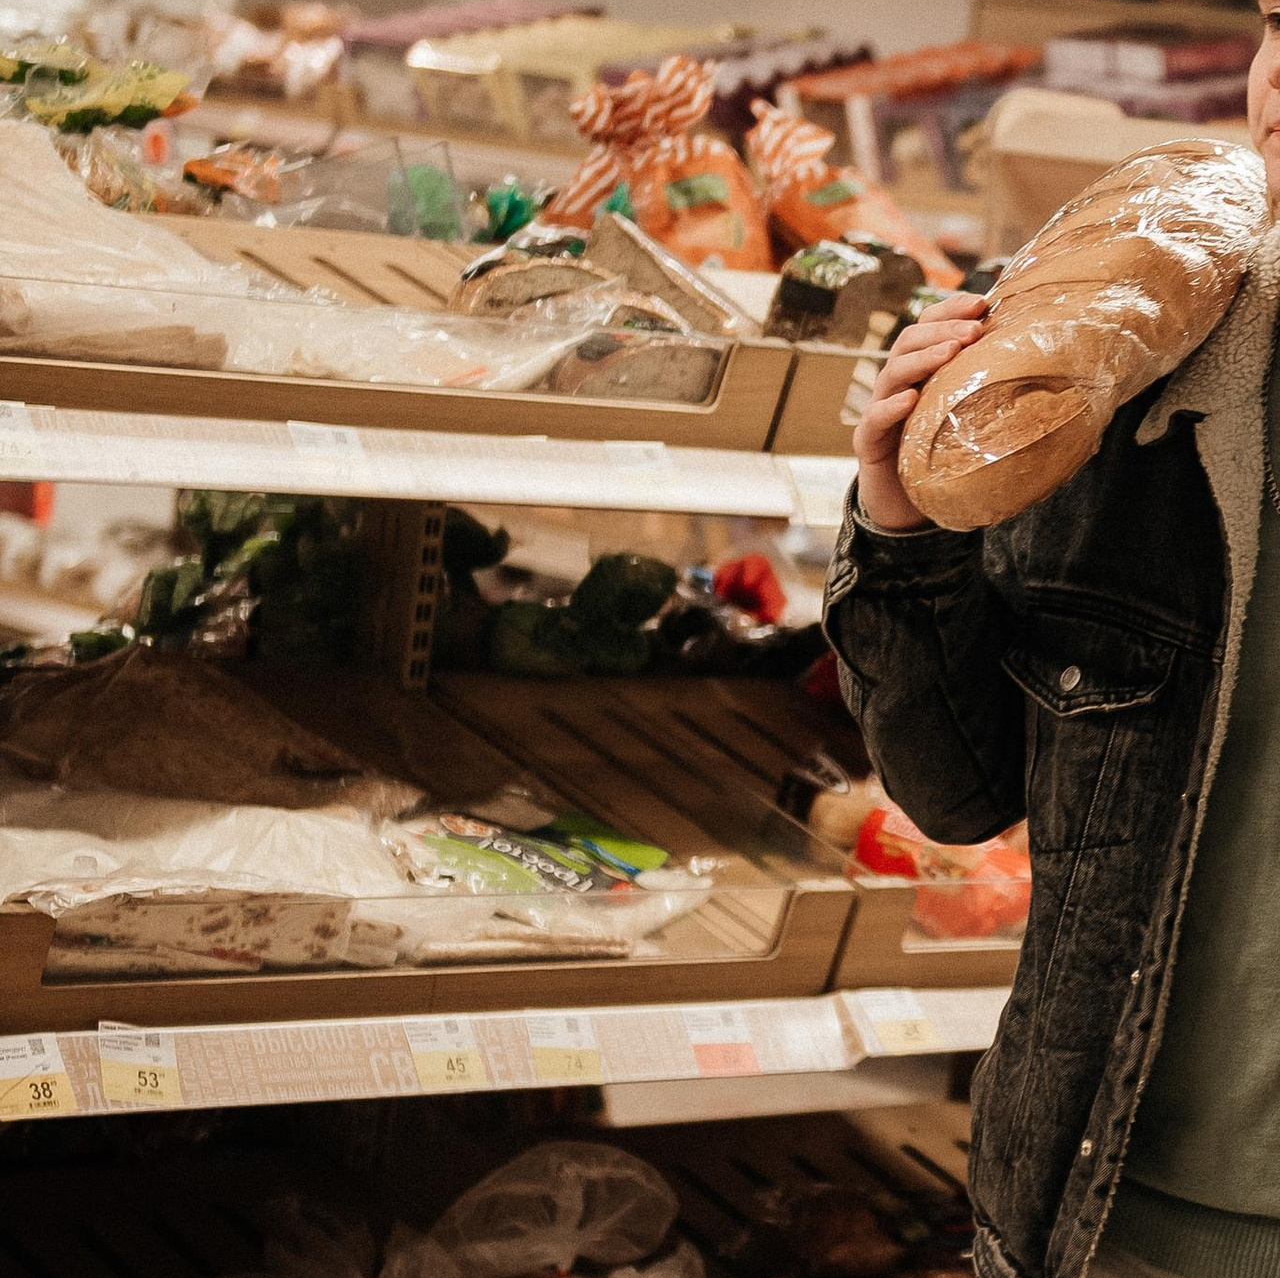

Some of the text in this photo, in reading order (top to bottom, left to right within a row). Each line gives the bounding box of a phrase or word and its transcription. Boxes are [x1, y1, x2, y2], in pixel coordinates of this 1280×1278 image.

[446, 1058, 466, 1073] 45
[138, 1071, 159, 1089] 53
[29, 1081, 53, 1100] 38
